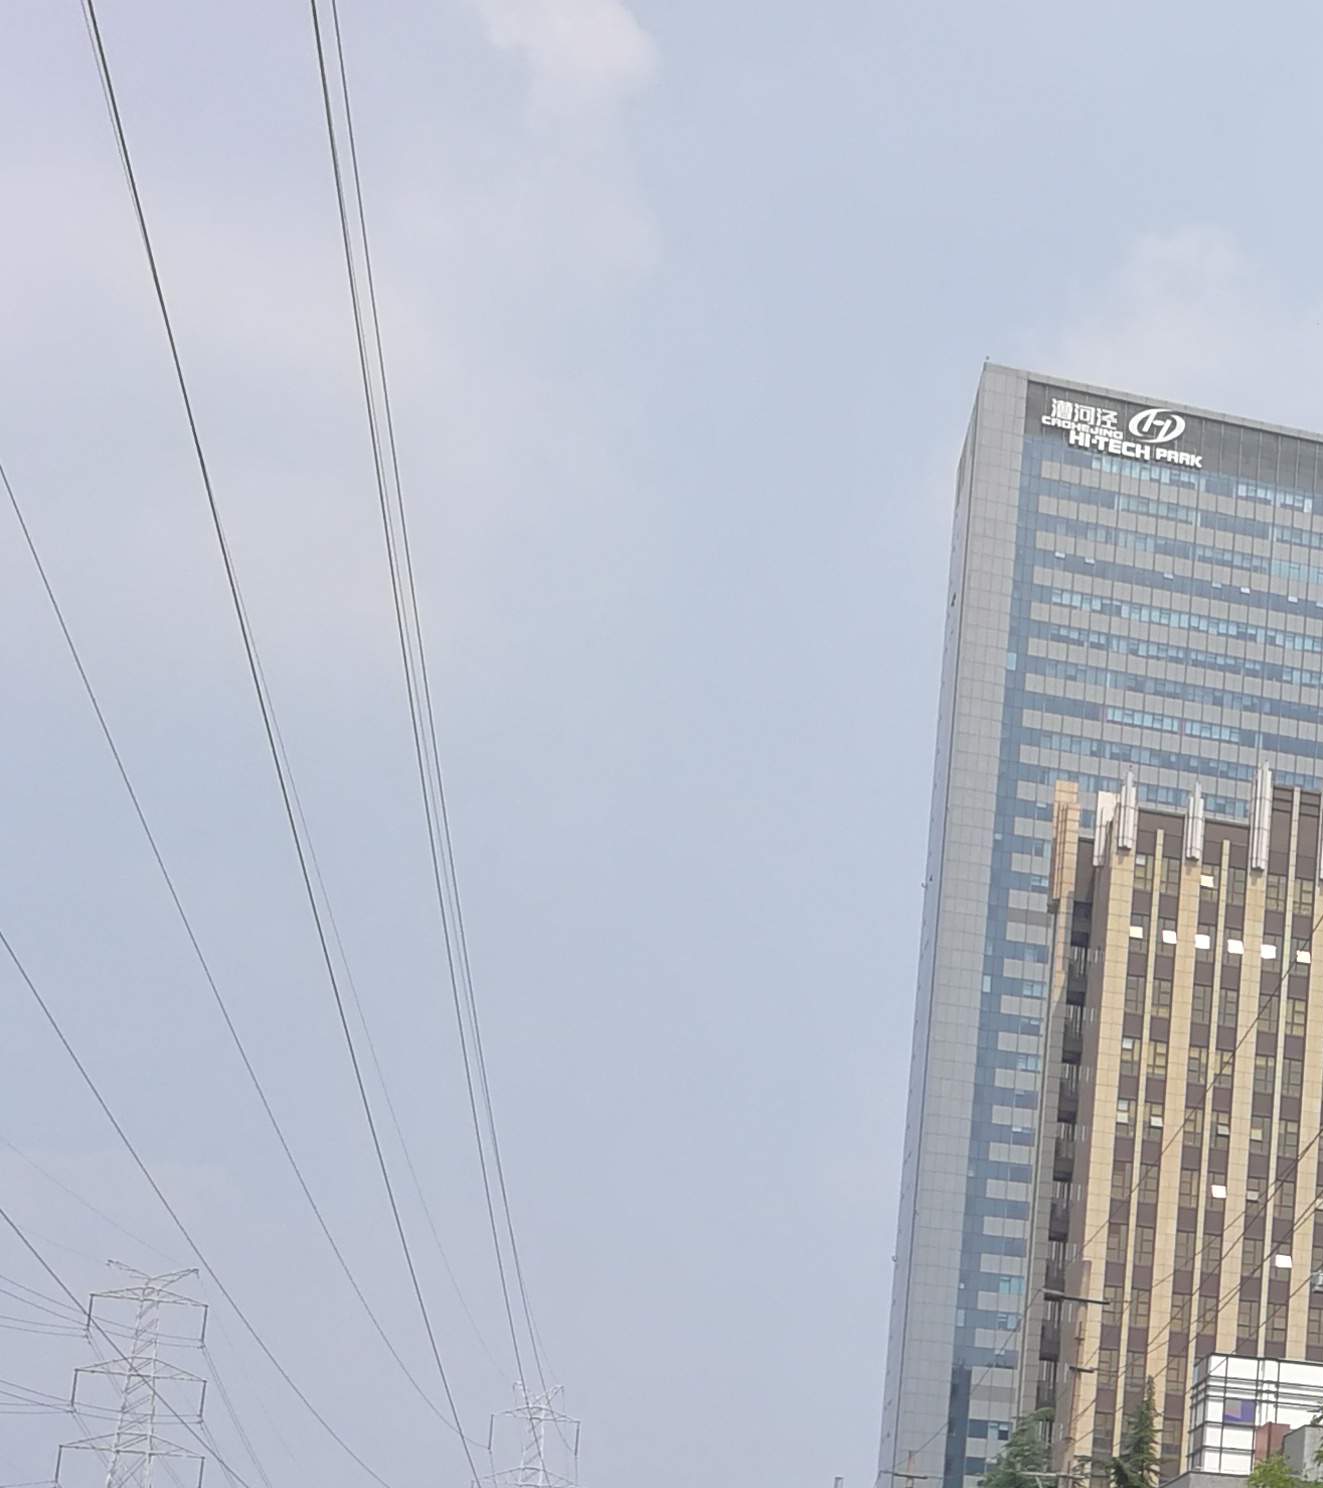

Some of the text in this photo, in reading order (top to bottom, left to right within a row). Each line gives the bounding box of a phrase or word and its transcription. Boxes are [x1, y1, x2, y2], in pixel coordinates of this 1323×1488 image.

[1051, 398, 1119, 430] 漕河泾
[1155, 447, 1203, 468] PARK
